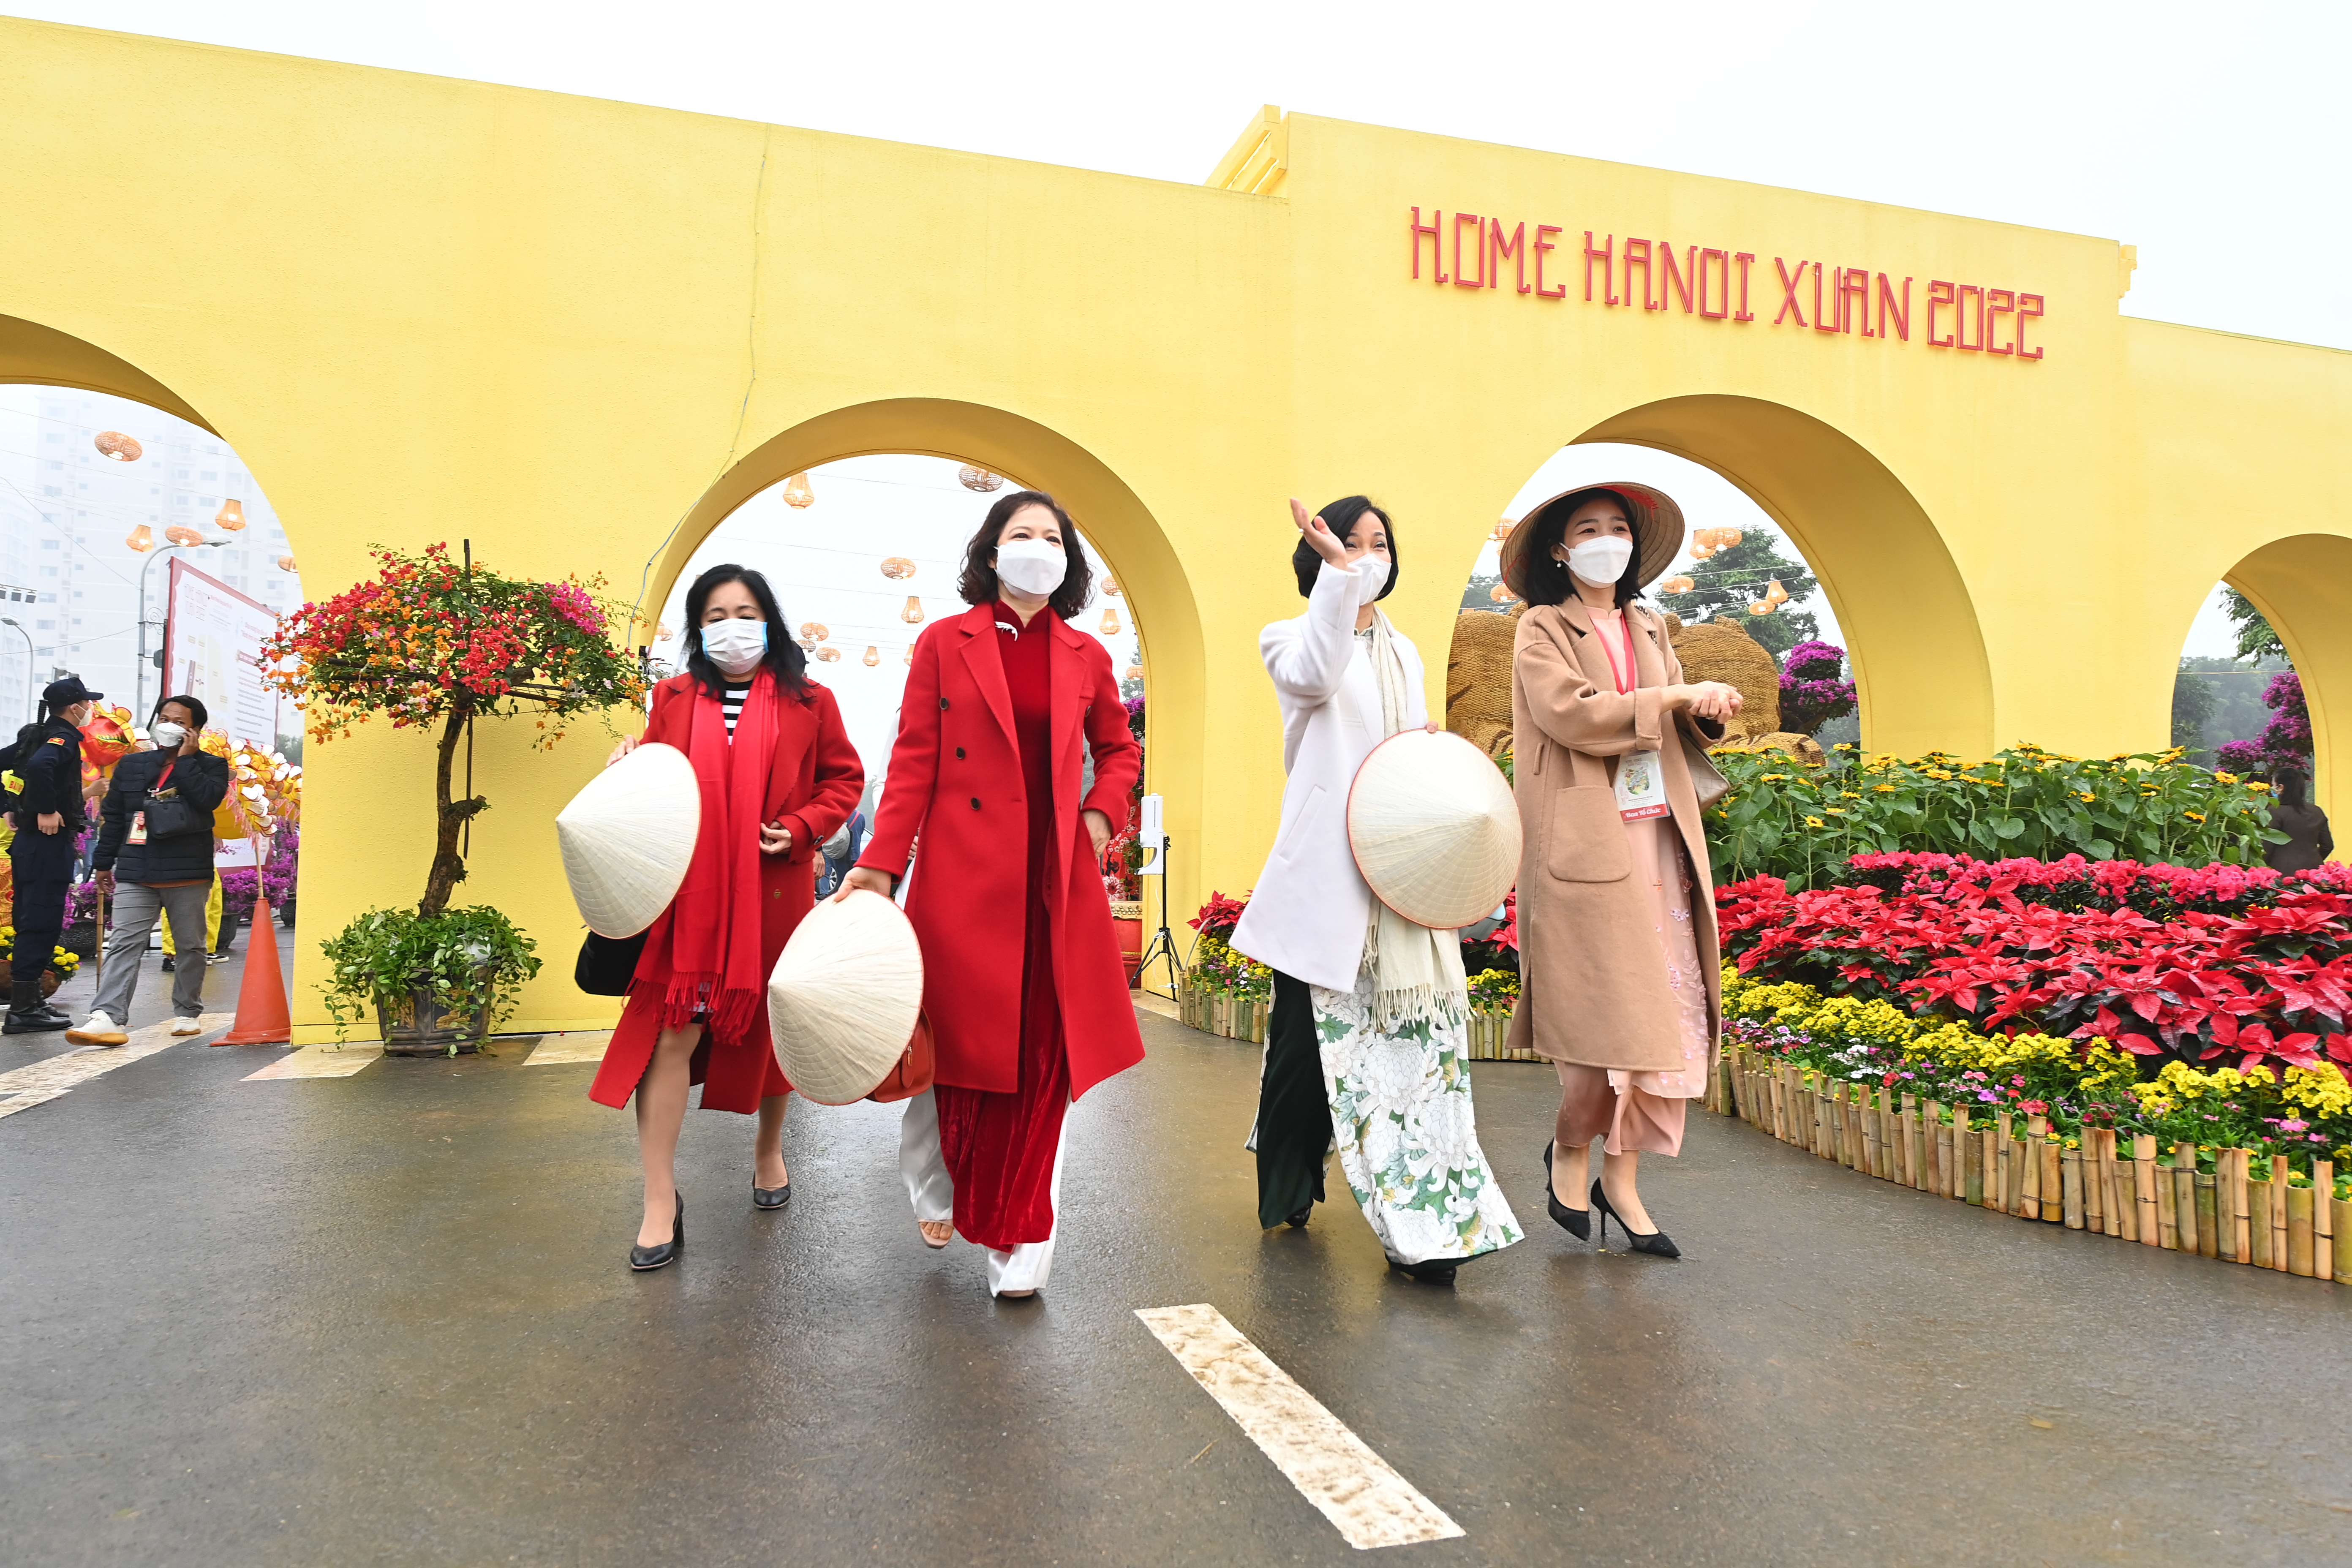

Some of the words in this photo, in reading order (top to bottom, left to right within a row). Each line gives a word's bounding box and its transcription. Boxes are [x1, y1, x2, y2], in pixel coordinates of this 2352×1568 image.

[1410, 207, 1565, 298] HOME
[1584, 231, 1755, 322] HANOI
[1774, 257, 1913, 341] XUAN
[1927, 280, 2044, 360] 2022
